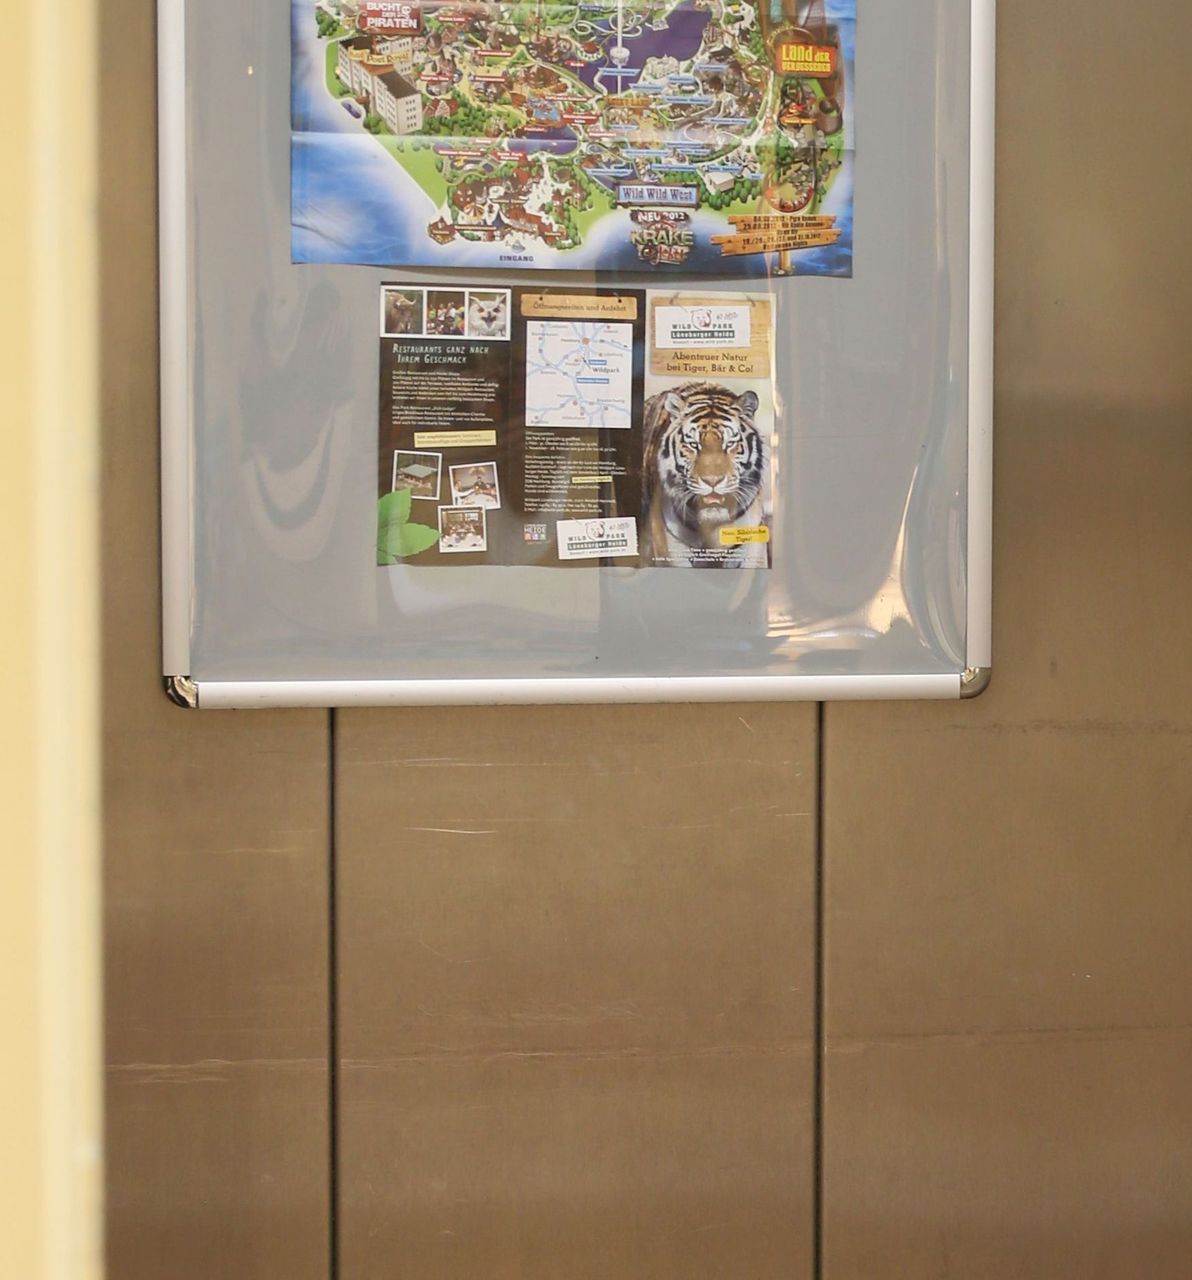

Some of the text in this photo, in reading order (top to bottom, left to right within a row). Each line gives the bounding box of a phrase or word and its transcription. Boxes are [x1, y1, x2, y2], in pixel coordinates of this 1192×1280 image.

[366, 2, 402, 11] BUCHT
[366, 17, 418, 29] PIRATEN
[622, 188, 693, 200] Wild Wild West
[637, 211, 661, 222] NEU
[630, 229, 694, 246] KRAKE
[672, 352, 748, 361] Abenteuer Natur
[667, 363, 680, 371] bei
[683, 363, 709, 373] Tiger,
[711, 363, 725, 372] Bär
[738, 364, 754, 373] Co!
